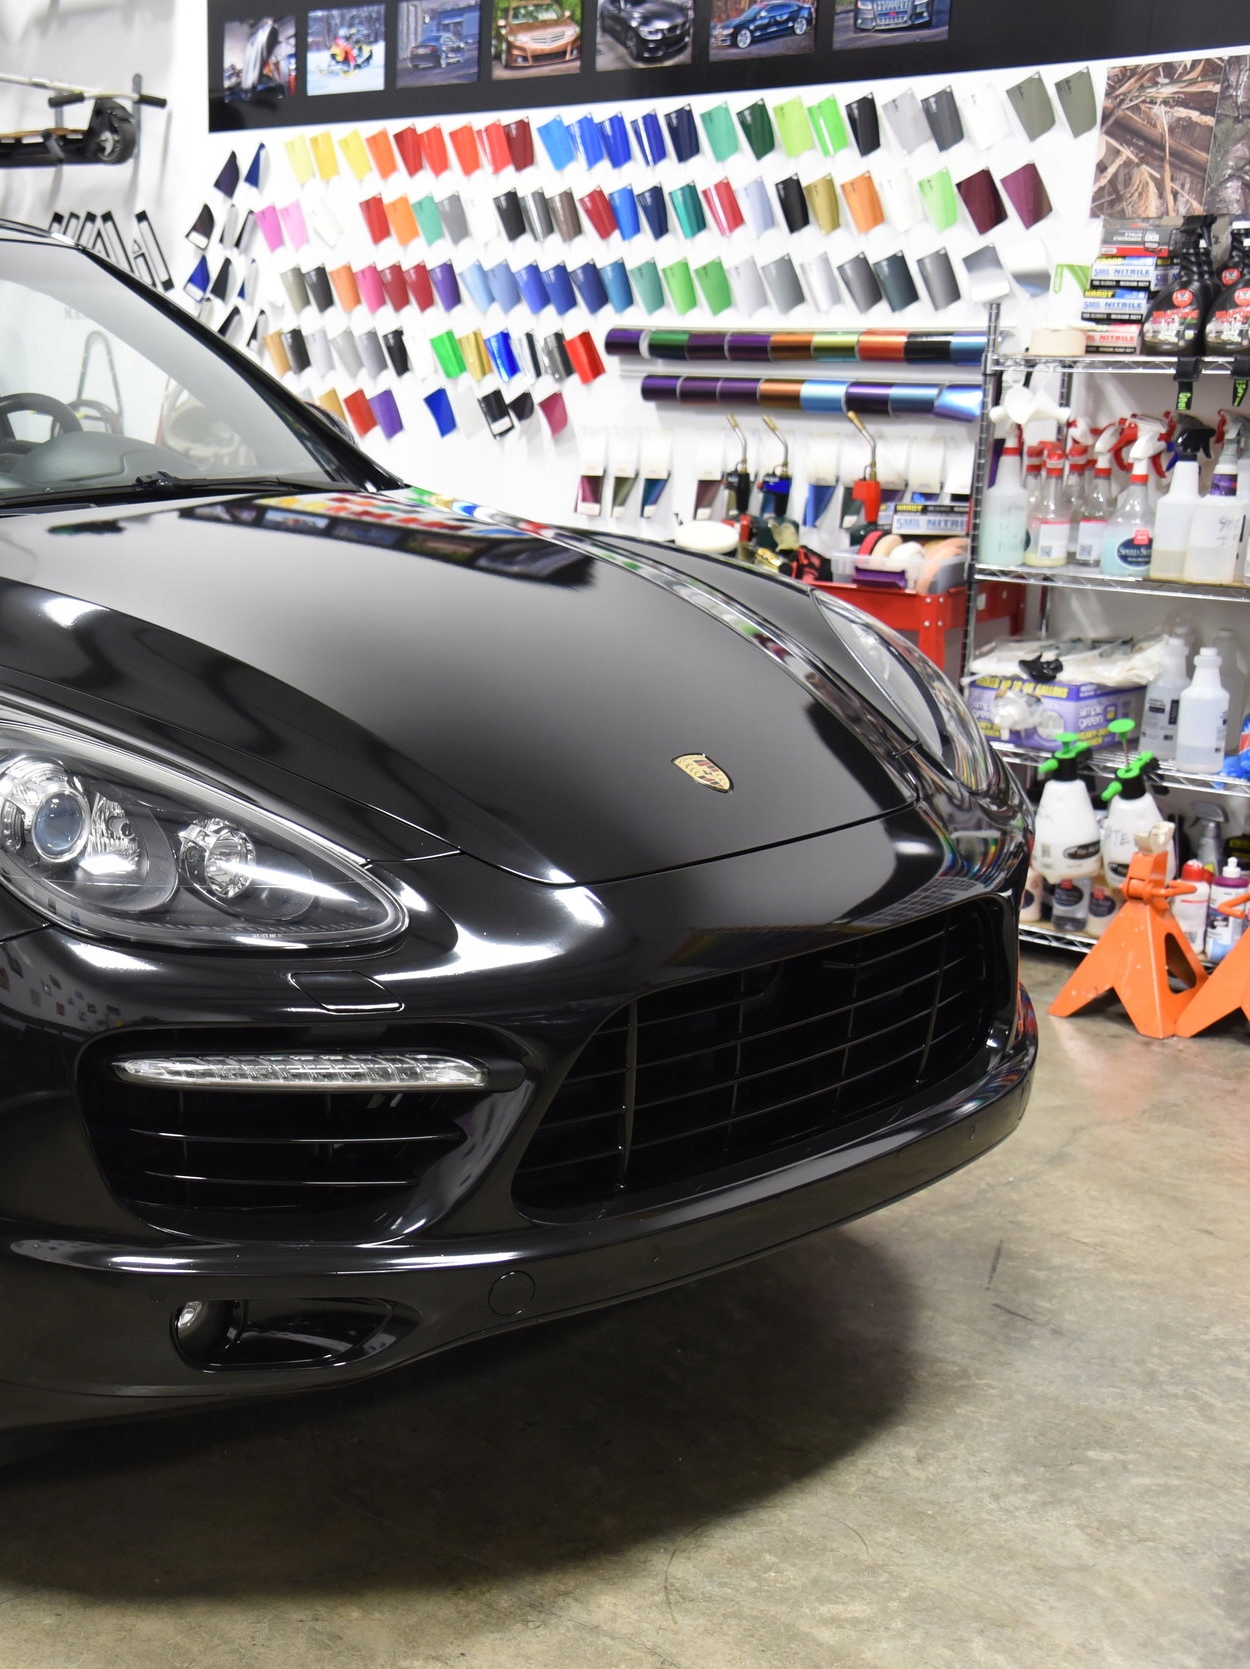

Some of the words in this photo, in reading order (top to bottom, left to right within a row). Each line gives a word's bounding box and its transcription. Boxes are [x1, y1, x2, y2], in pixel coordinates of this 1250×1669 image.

[1113, 268, 1151, 276] NITRILE
[1104, 301, 1143, 309] NITRILE
[1099, 335, 1136, 343] NITRILE
[926, 519, 966, 530] NITRI
